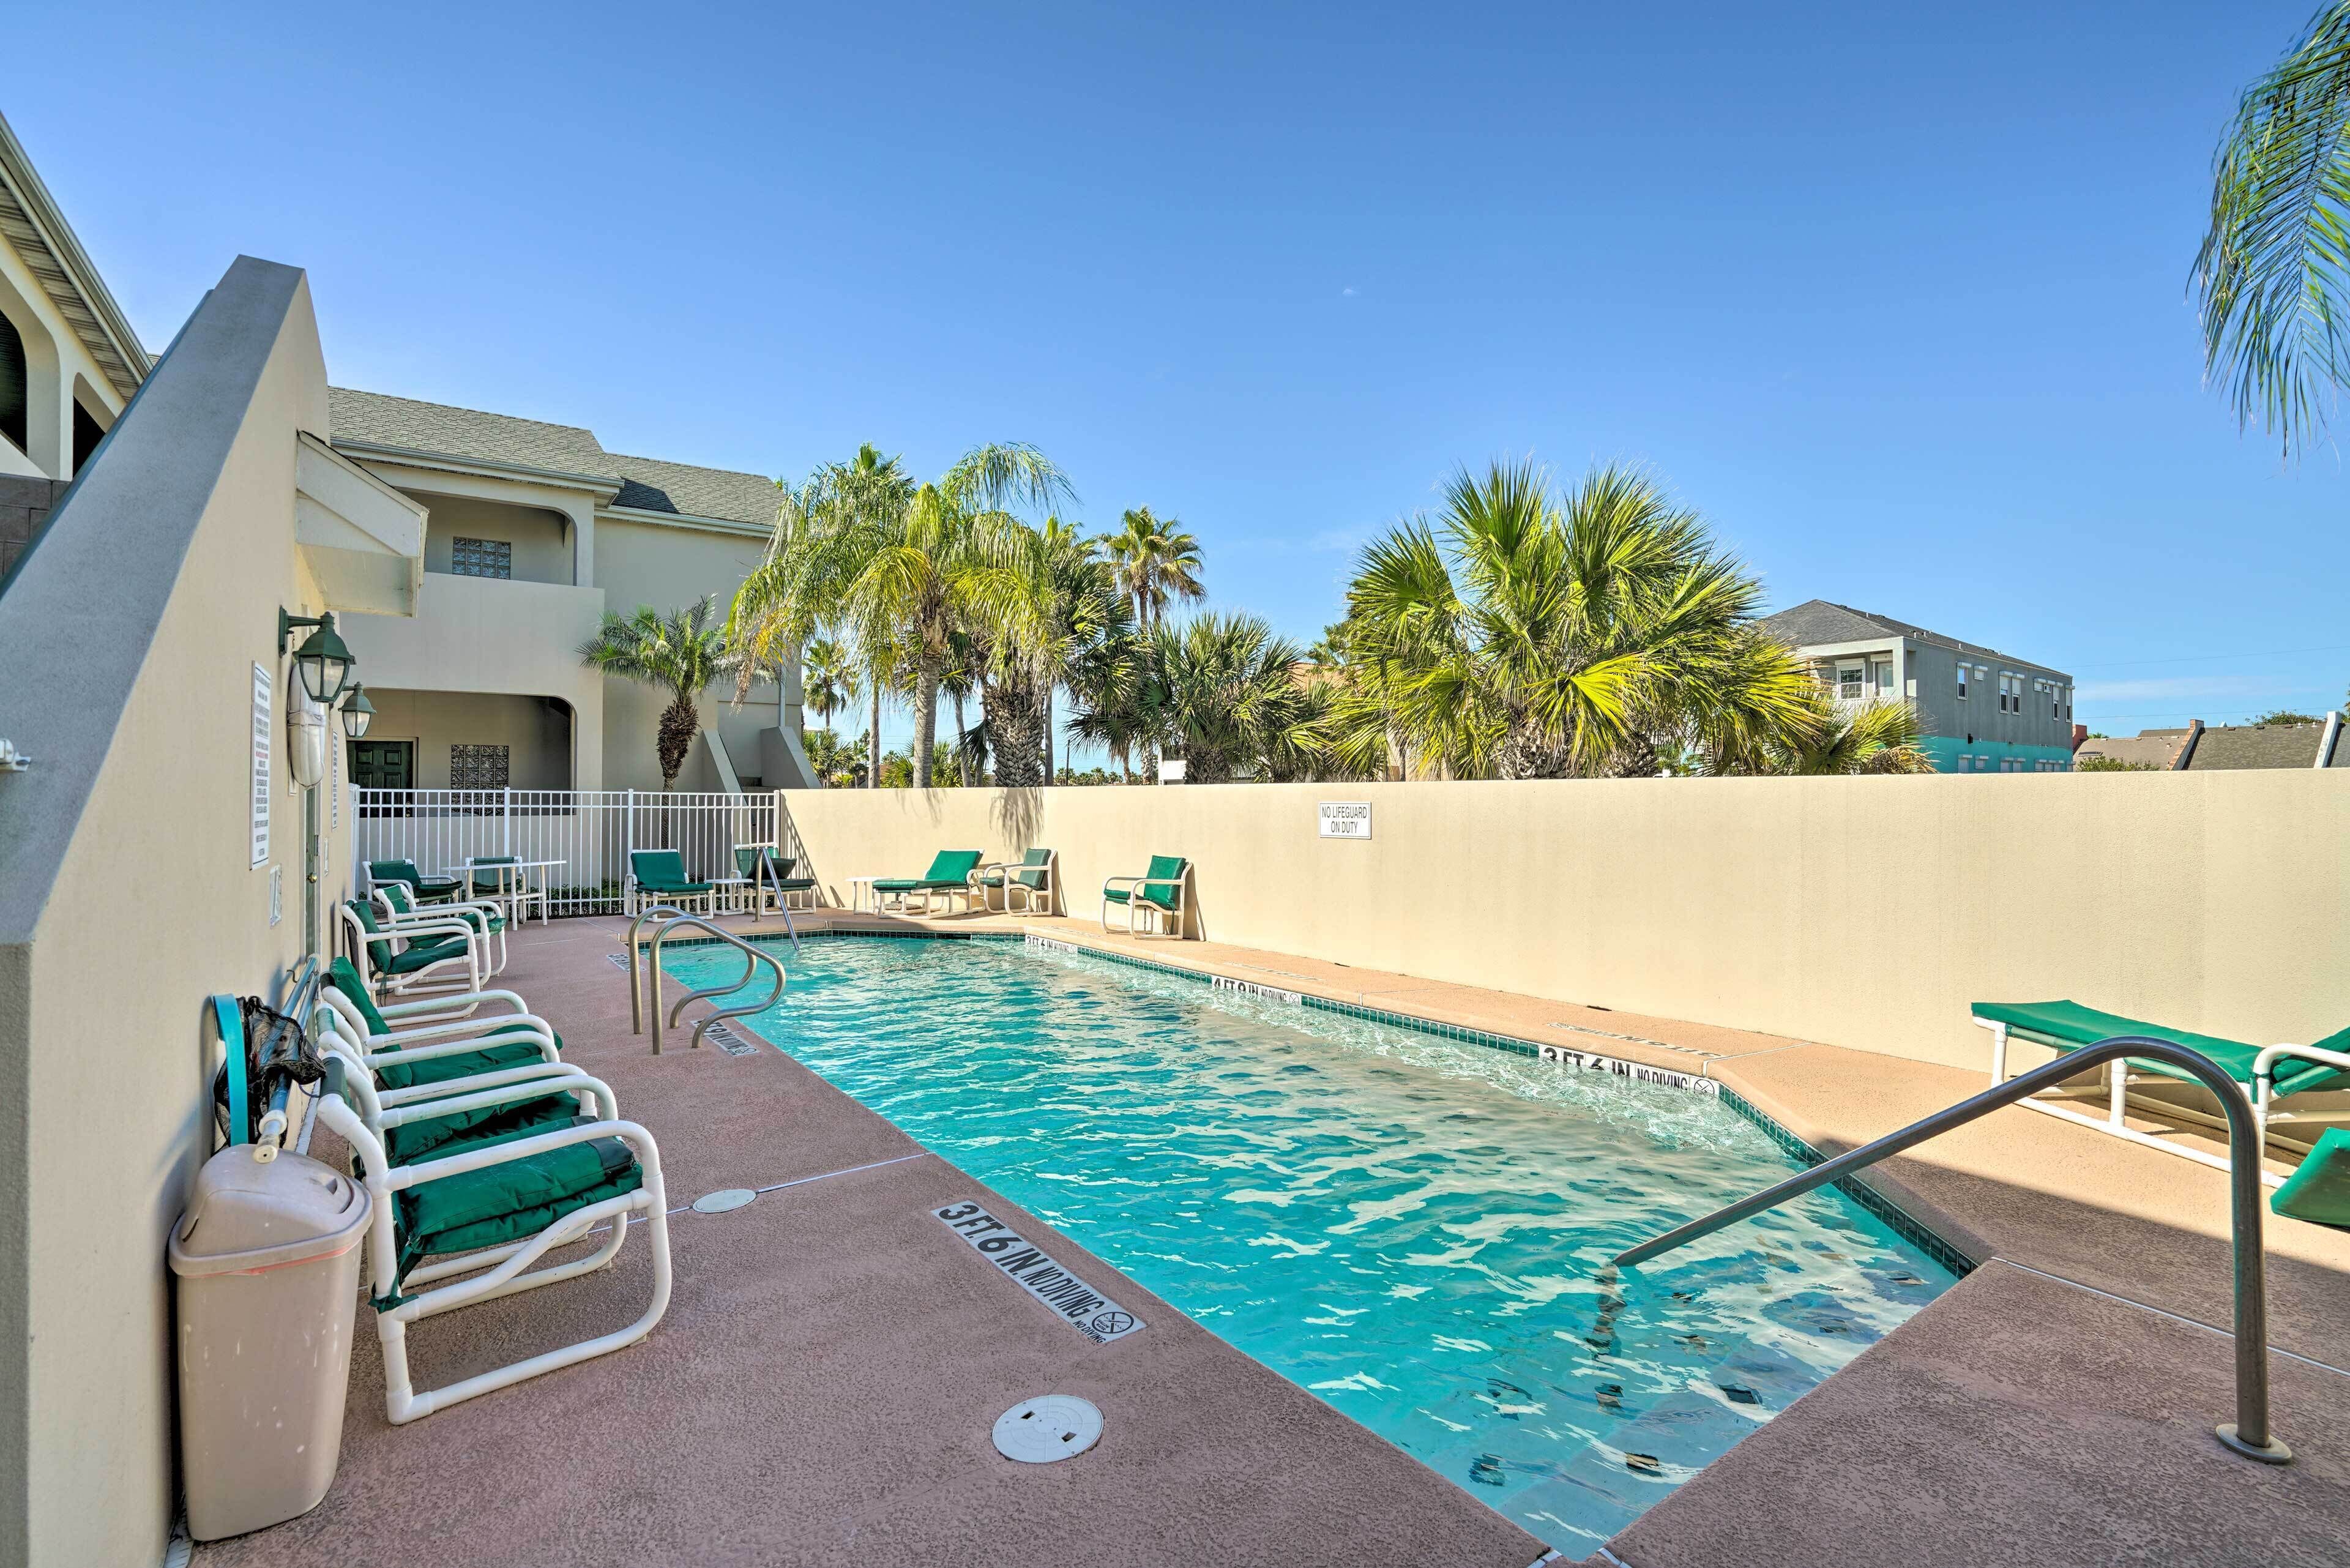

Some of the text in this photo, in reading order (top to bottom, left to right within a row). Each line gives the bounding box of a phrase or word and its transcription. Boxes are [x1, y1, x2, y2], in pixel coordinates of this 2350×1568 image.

[1322, 806, 1367, 818] NO LIFEGUARD
[1330, 821, 1358, 834] ON DUTY
[1248, 984, 1258, 995] IN
[1269, 990, 1287, 1002] DIVING
[1637, 1067, 1650, 1082] NO
[1652, 1071, 1688, 1091] DIVING
[939, 1204, 979, 1220] 3
[977, 1237, 1023, 1252] 6
[1020, 1266, 1064, 1286] NO
[1035, 1277, 1106, 1318] DIVING
[1072, 1320, 1106, 1344] NO DIVING
